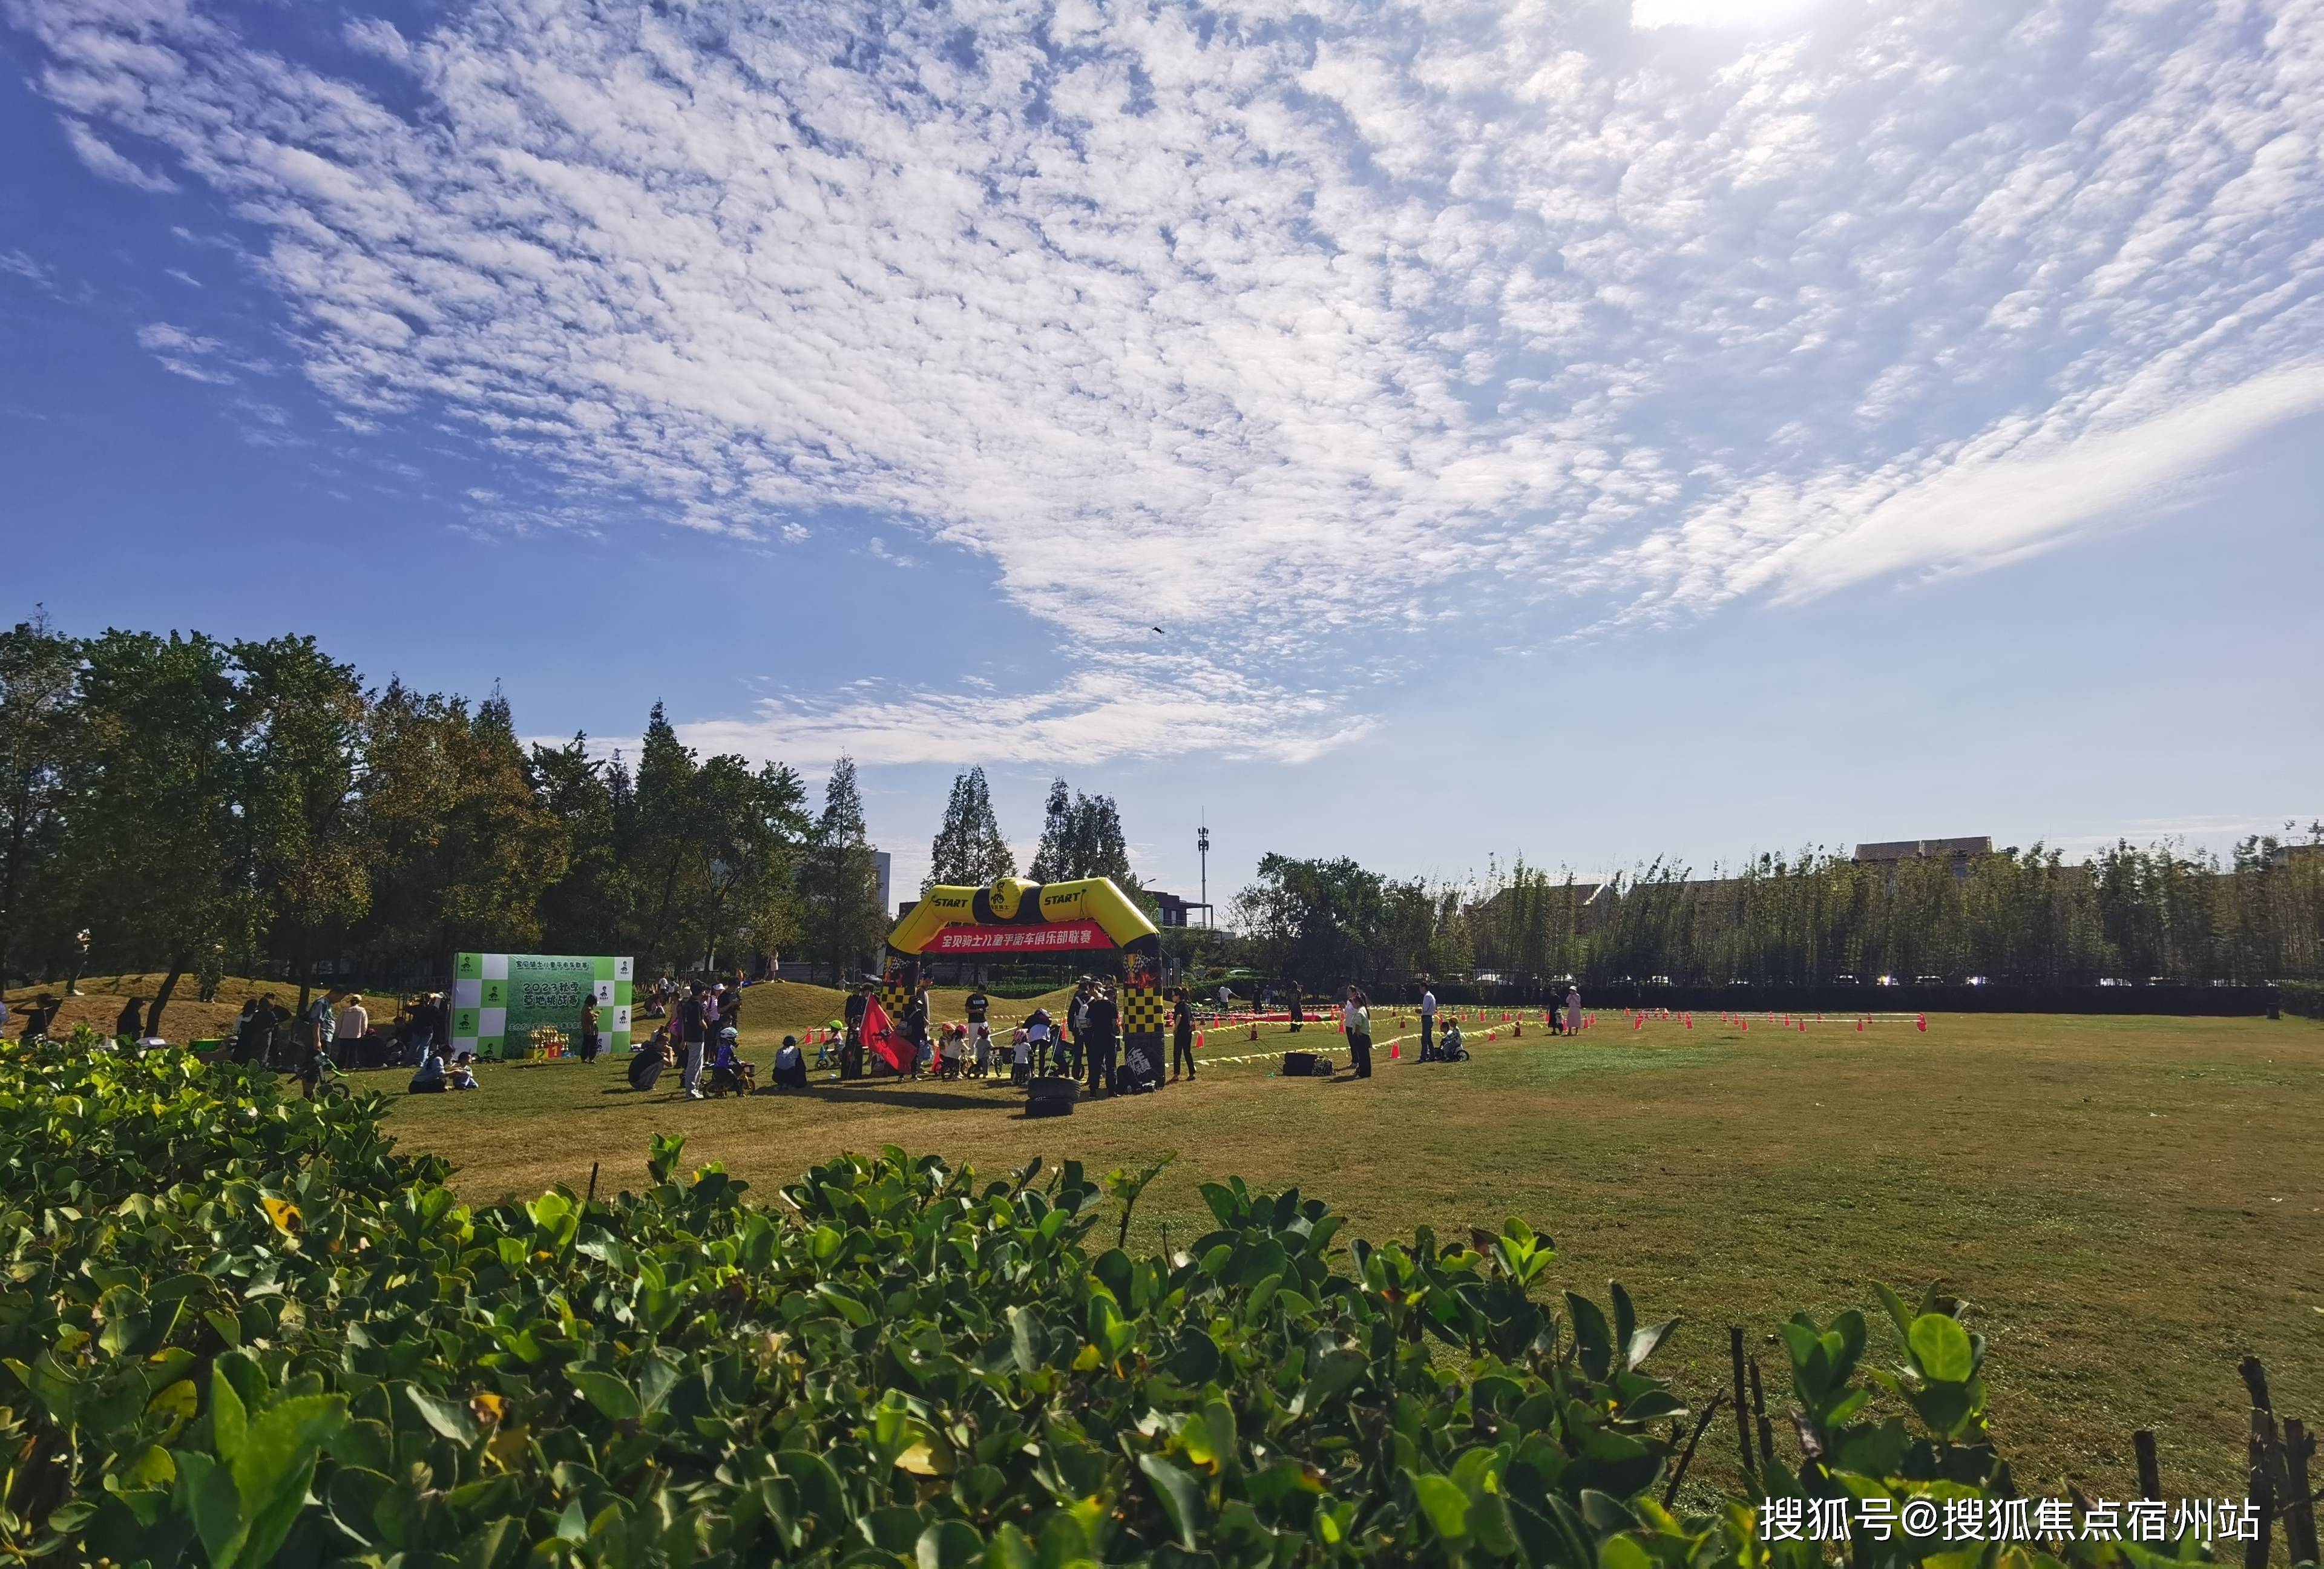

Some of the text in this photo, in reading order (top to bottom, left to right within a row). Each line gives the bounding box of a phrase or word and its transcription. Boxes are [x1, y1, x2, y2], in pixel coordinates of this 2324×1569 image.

[934, 898, 968, 907] START
[1044, 892, 1080, 906] START
[942, 930, 1092, 947] 宝贝骑士儿童平衡车俱乐部联赛
[523, 982, 579, 993] 2023秋季
[524, 995, 579, 1006] 草地挑战赛
